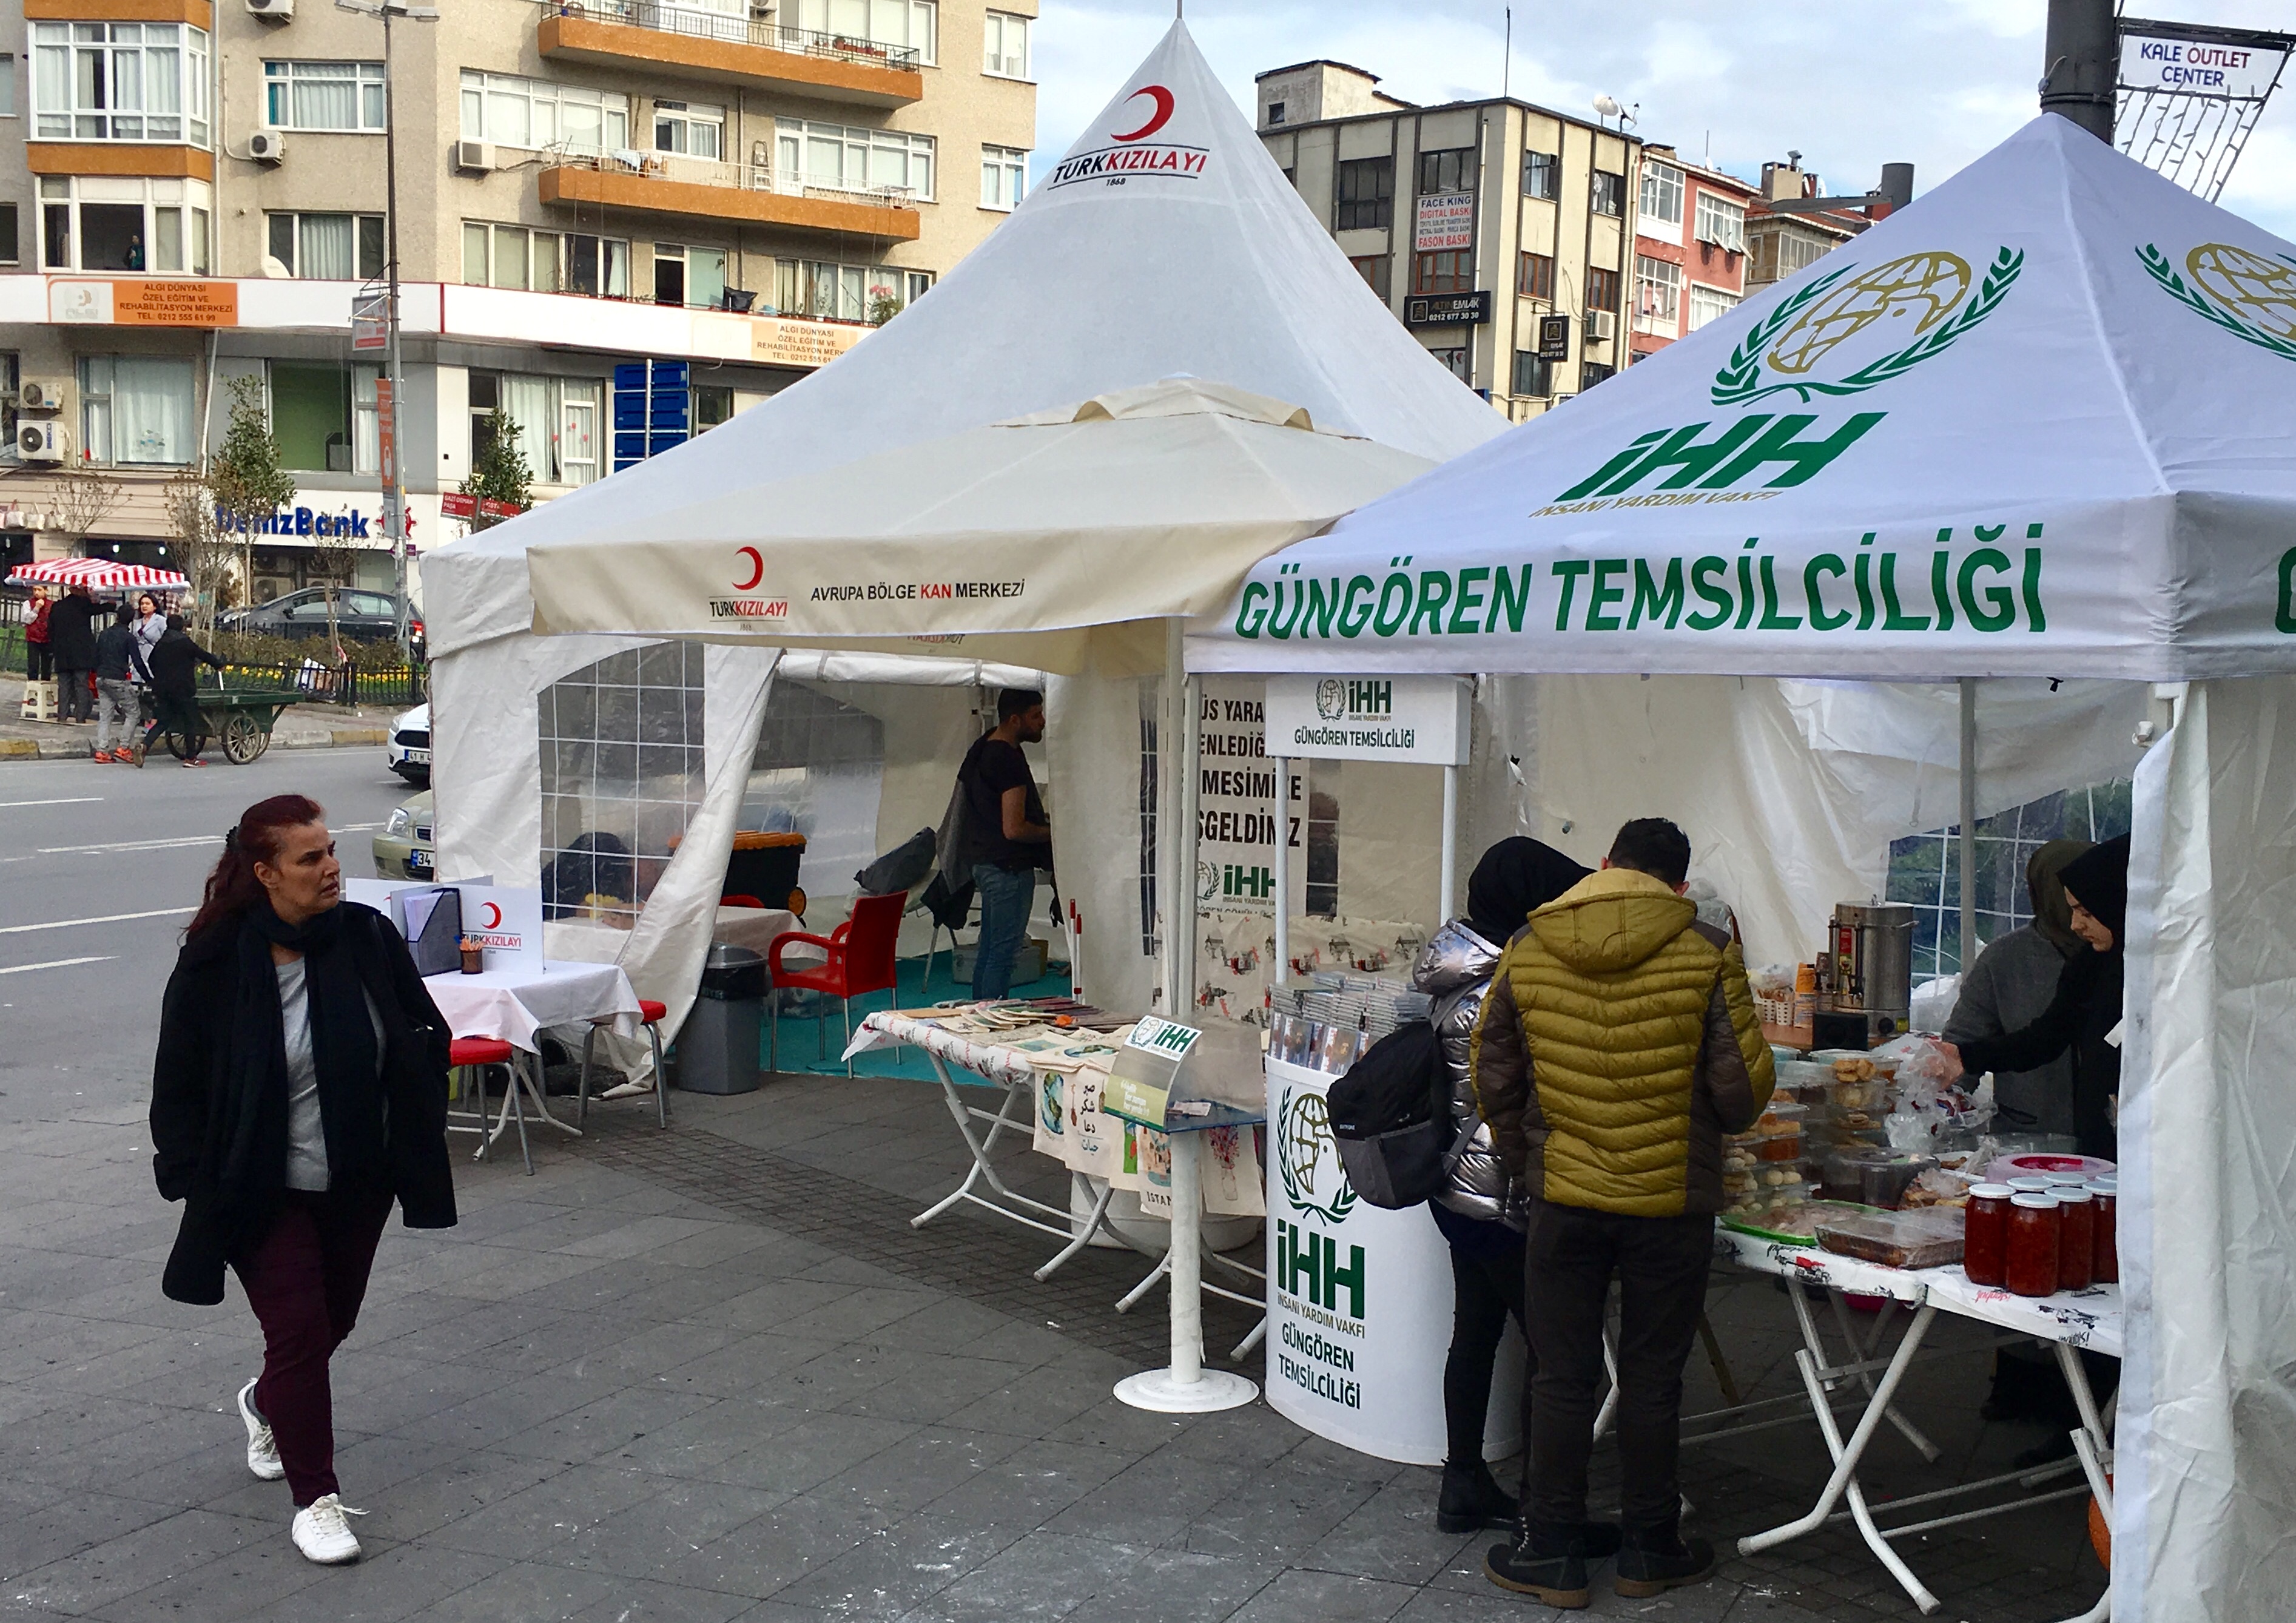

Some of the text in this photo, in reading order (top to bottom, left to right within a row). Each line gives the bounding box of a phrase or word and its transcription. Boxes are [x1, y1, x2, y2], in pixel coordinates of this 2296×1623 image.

[2140, 42, 2251, 69] KALE OUTLET
[2161, 66, 2224, 87] CENTER
[1106, 178, 1126, 187] 1868
[1421, 195, 1471, 208] FACE KING
[1450, 207, 1472, 217] BASKI
[1419, 234, 1470, 248] FASON BASKI
[167, 283, 206, 292] DÜNYASI
[142, 292, 164, 301] ÖZEL
[195, 304, 232, 312] MERKEZİ
[780, 325, 834, 337] ALGI DÜNYASI
[778, 334, 797, 343] ÖZEL
[790, 354, 807, 362] 0212
[824, 348, 845, 357] MERK
[1610, 493, 1706, 510] YARDIM
[1704, 491, 1783, 504] VAKFI
[1234, 522, 2046, 639] GÜNGÖREN TEMSİLCİLİĞİ
[811, 578, 1025, 602] AVRUPA BÖLGE KAN MERKEZİ
[1224, 700, 1264, 723] YARA
[1294, 726, 1415, 749] GÜNGÖREN TEMSİLCİLİĞİ
[419, 853, 431, 865] 34
[1146, 1191, 1172, 1206] ISTAN
[1301, 1303, 1333, 1329] YARDIM
[1336, 1317, 1365, 1339] VAKFI
[1282, 1321, 1354, 1372] GÜNGÖREN
[1278, 1353, 1361, 1409] TEMSİLCİLİĞİ
